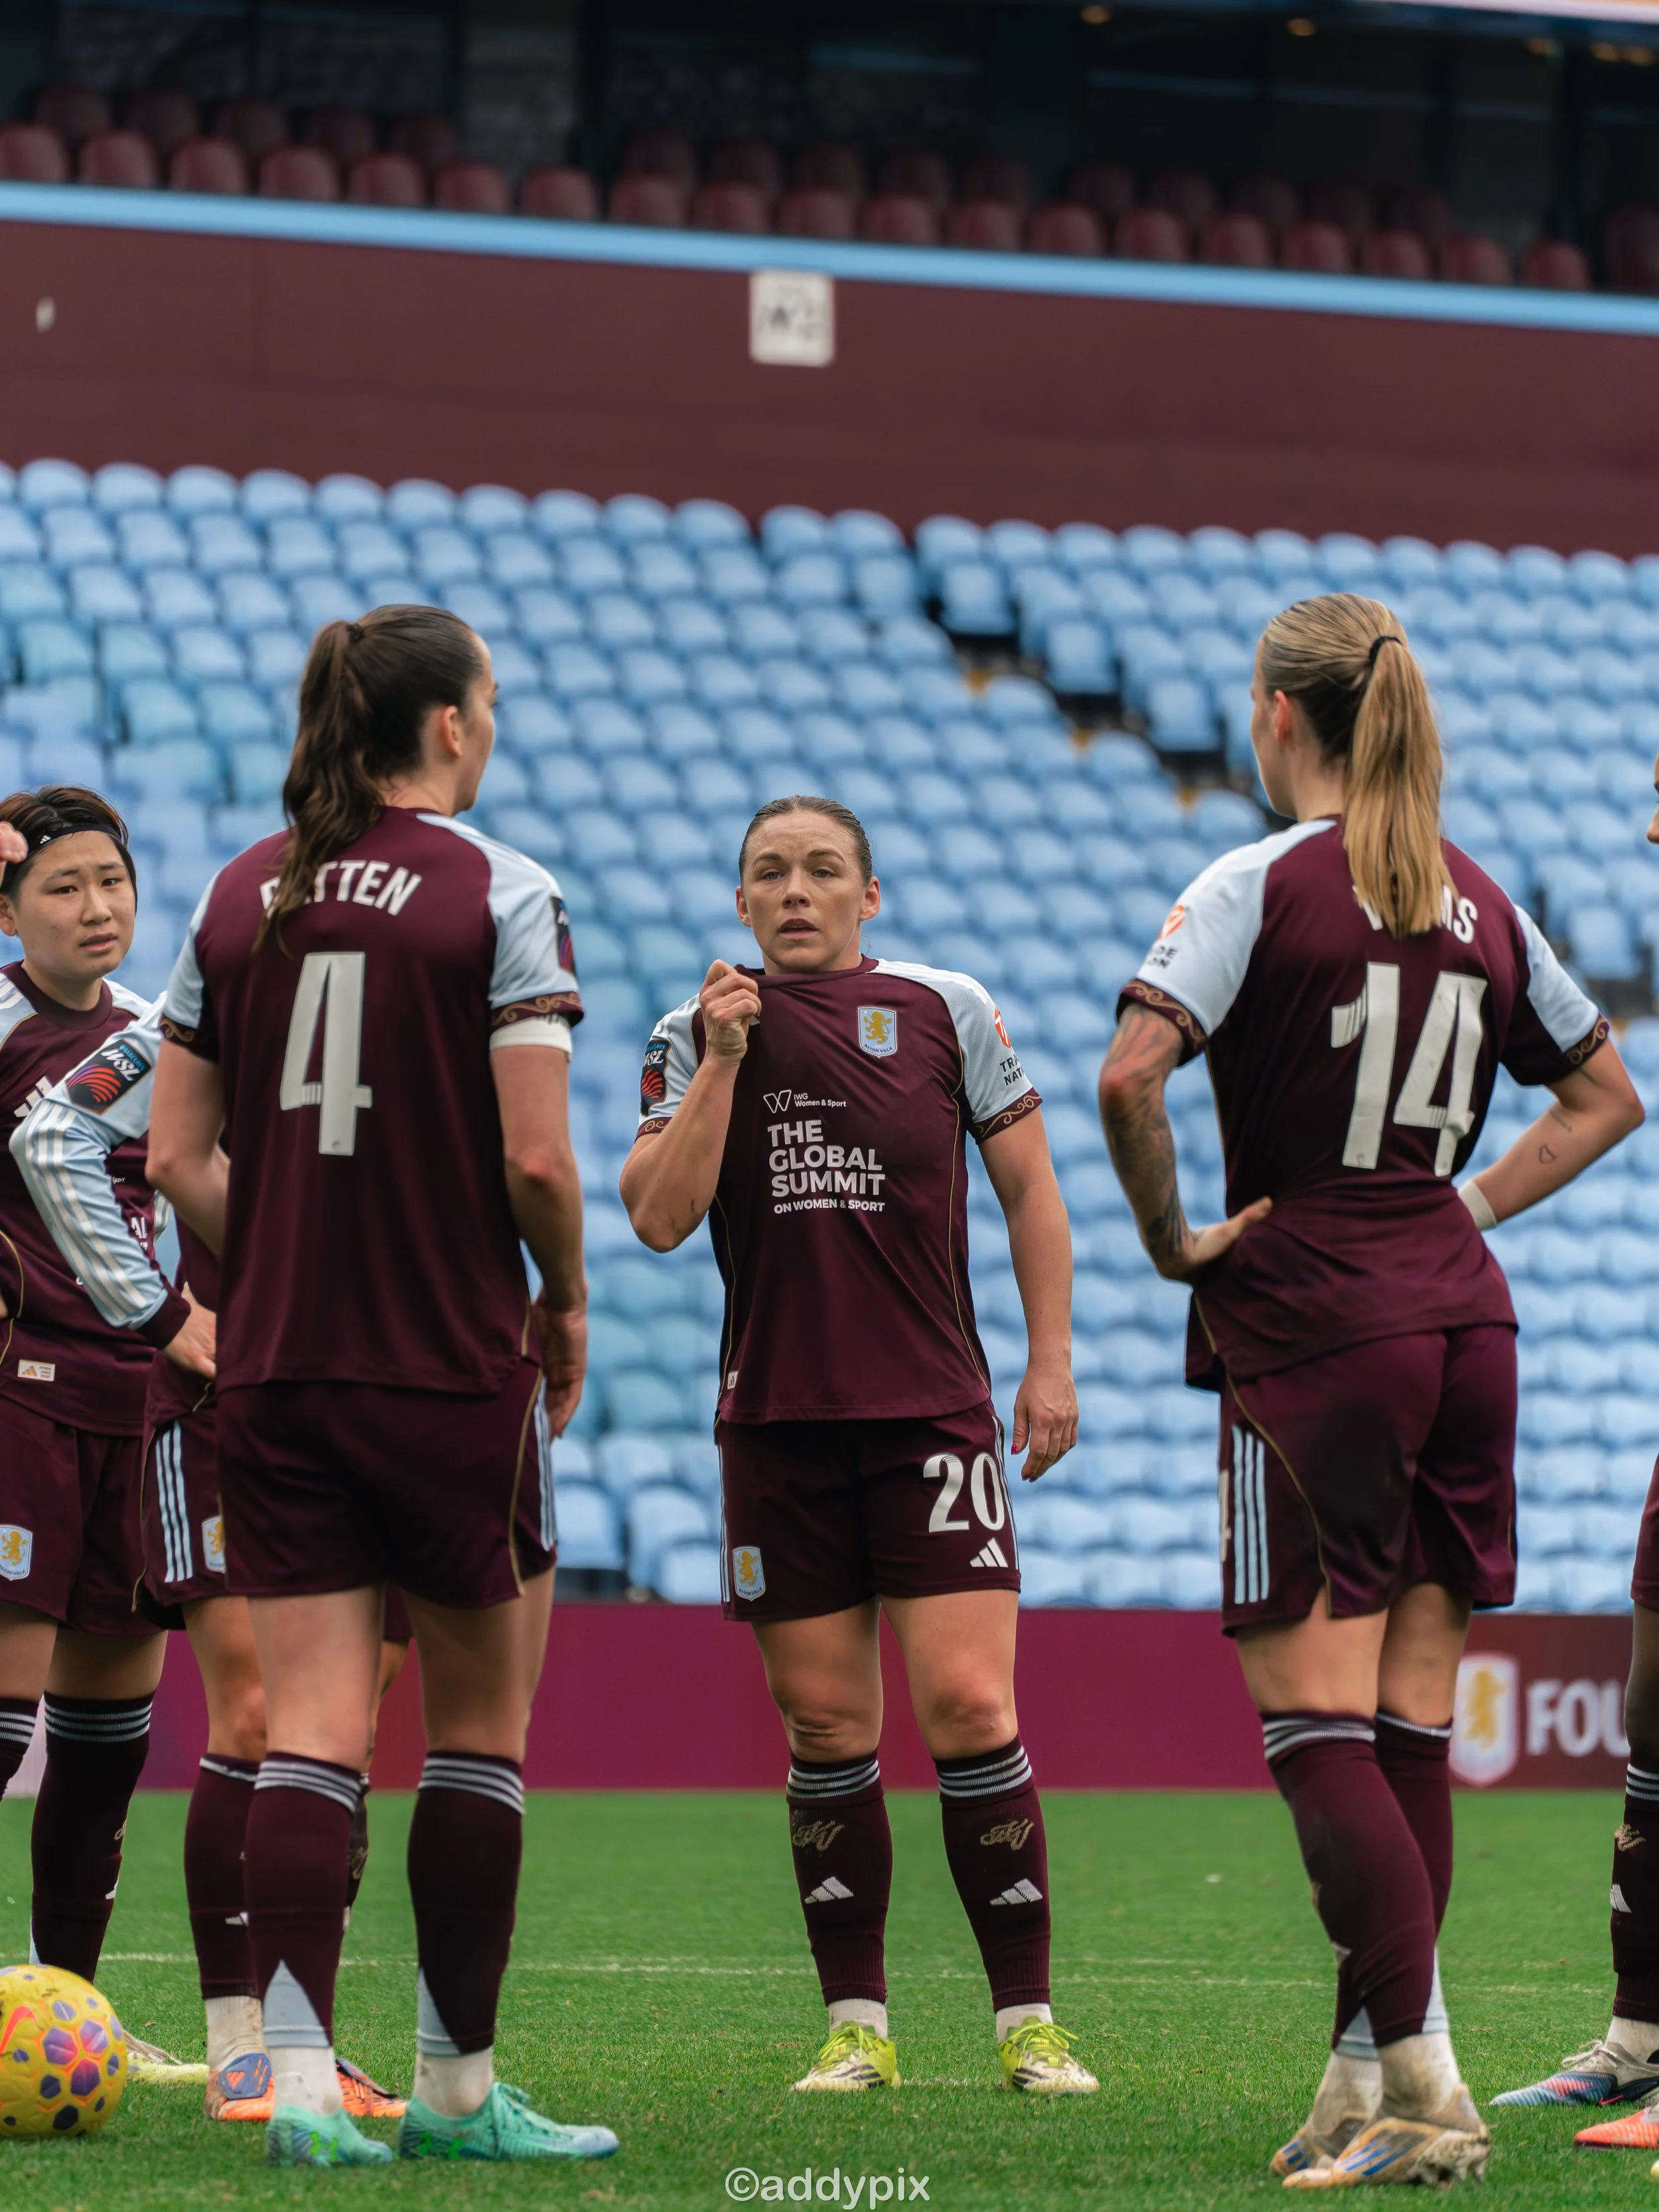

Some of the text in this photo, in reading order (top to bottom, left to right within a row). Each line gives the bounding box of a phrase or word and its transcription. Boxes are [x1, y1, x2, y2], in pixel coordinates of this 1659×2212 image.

[259, 859, 422, 919] PTTEN
[279, 951, 372, 1156] 4
[863, 1044, 879, 1053] ASTON
[100, 1048, 140, 1081] WSL
[1004, 1067, 1024, 1086] NAT
[1331, 961, 1488, 1177] 14
[767, 1120, 824, 1147] THE
[769, 1145, 883, 1172] GLOBAL
[771, 1170, 885, 1197] SUMMIT
[774, 1203, 792, 1214] ON
[794, 1199, 837, 1211] WOMEN
[848, 1200, 885, 1212] SPORT
[923, 1451, 1005, 1532] 20
